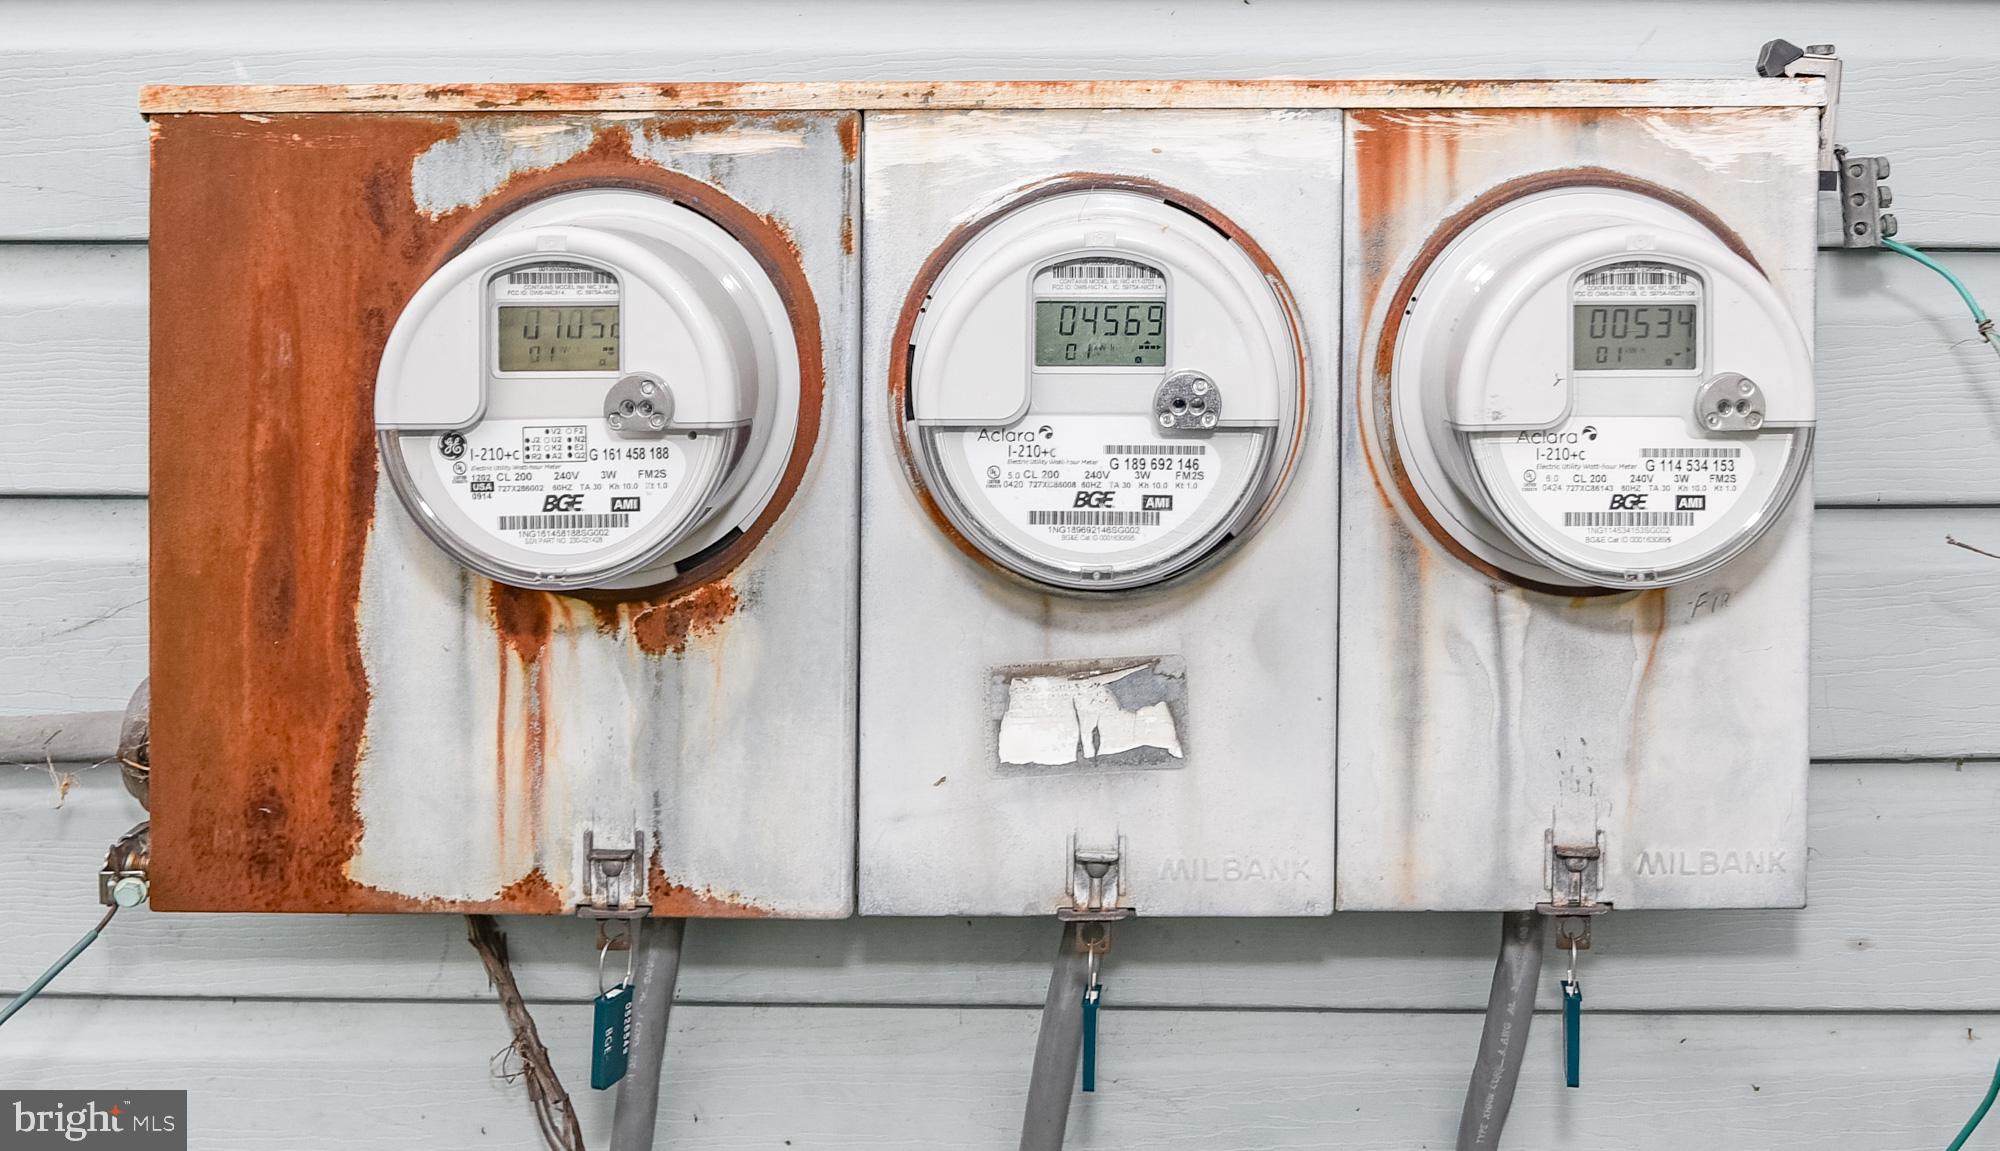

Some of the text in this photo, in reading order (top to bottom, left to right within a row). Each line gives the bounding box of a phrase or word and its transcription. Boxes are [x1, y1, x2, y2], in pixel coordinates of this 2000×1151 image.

[1059, 305, 1163, 336] 04569
[1590, 308, 1694, 339] 00534
[977, 428, 1035, 442] Aclara
[1516, 430, 1578, 444] Aclara
[589, 447, 669, 460] G 161 458 188
[1109, 457, 1200, 470] G 189 692 146
[1645, 459, 1735, 472] G 114 534 153
[496, 472, 511, 481] CL
[515, 472, 532, 481] 200
[554, 471, 580, 480] 240V
[600, 471, 617, 479] 3W
[638, 469, 667, 478] FM2S
[1023, 470, 1038, 479] CL
[1041, 470, 1059, 479] 200
[1085, 471, 1110, 480] 240V
[1134, 471, 1151, 479] 3W
[1175, 472, 1205, 480] FM2S
[1573, 474, 1586, 483] CL
[1590, 474, 1607, 483] 200
[1630, 474, 1654, 483] 240V
[1673, 474, 1690, 482] 3W
[1709, 474, 1736, 483] FM2S
[471, 482, 494, 491] USA
[542, 494, 584, 512] BGE
[612, 498, 640, 511] AMI
[1073, 490, 1116, 508] BGE
[1143, 496, 1172, 510] AMI
[1609, 493, 1649, 510] BGE
[1677, 496, 1705, 510] AMI
[1159, 856, 1311, 882] MILBANK
[1635, 850, 1787, 876] MILBANK
